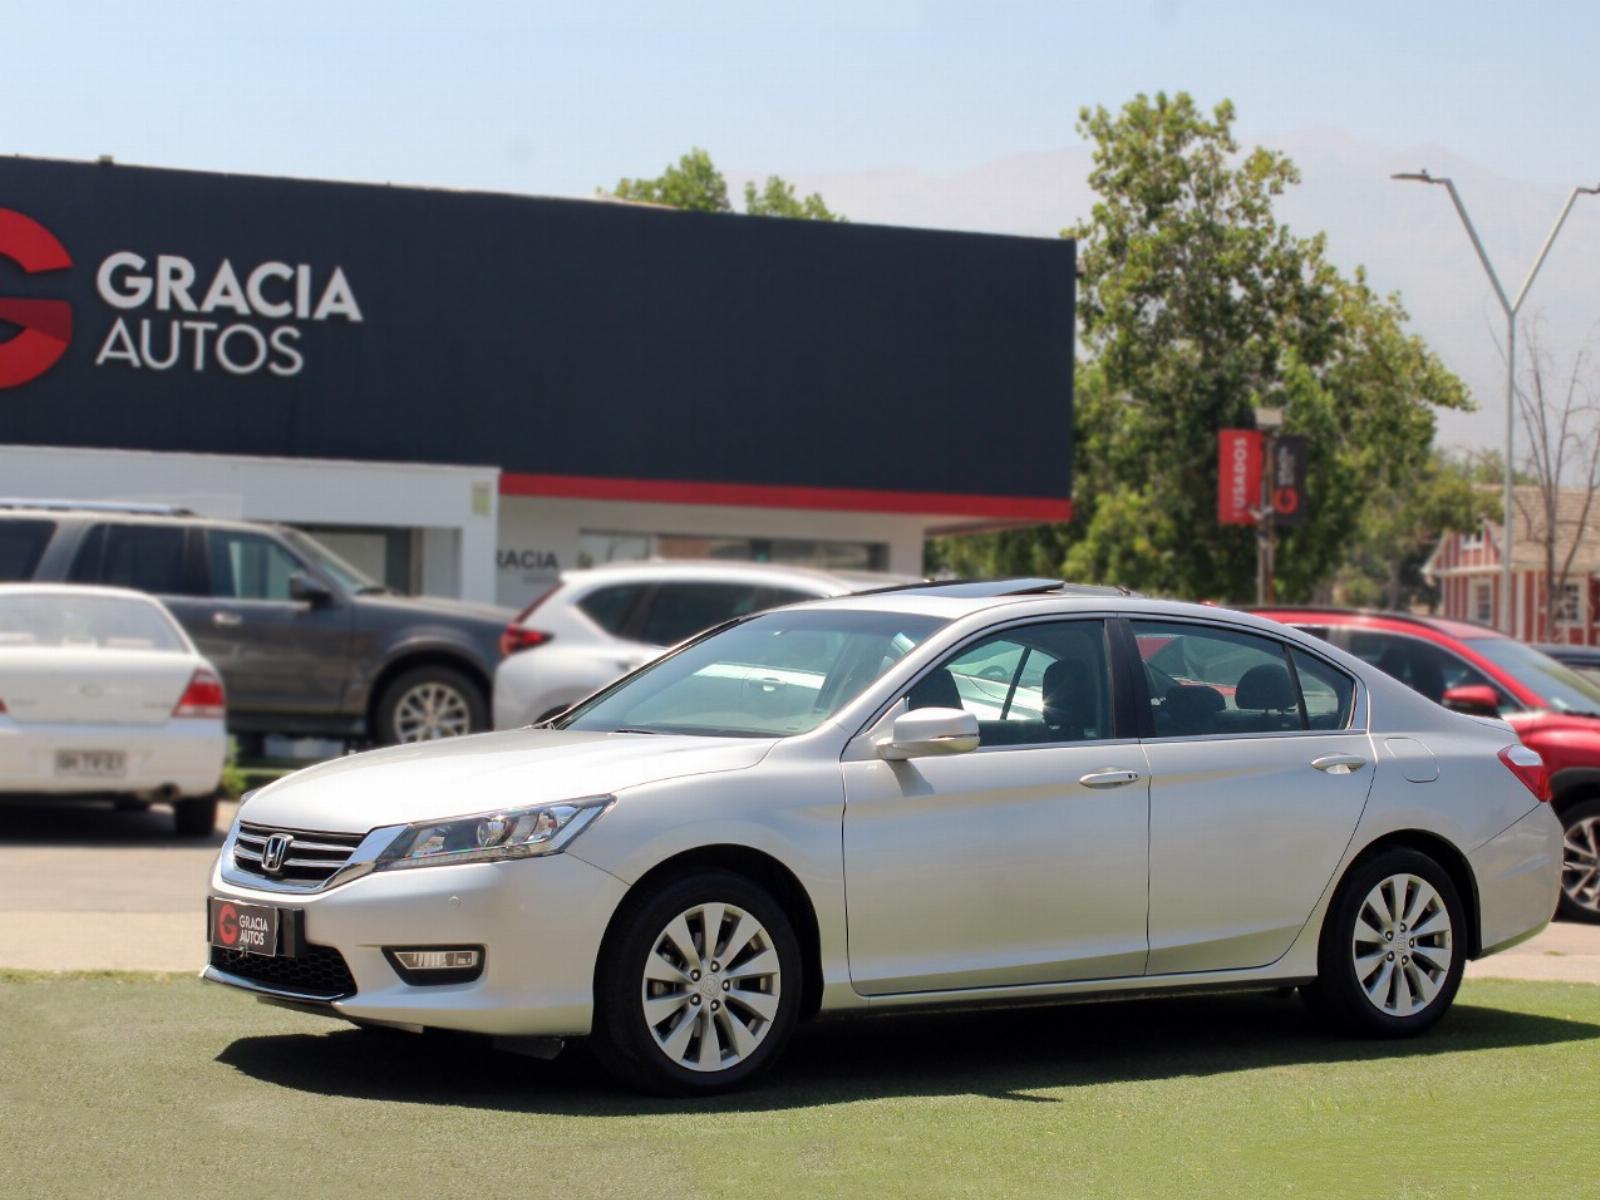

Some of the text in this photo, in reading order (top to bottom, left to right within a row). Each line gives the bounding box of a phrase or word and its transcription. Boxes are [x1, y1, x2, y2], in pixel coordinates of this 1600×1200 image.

[97, 251, 363, 322] GRACIA
[95, 316, 304, 376] AUTOS
[1232, 437, 1247, 509] USADOS
[239, 914, 268, 932] GRACIA
[239, 929, 264, 945] AUTOS
